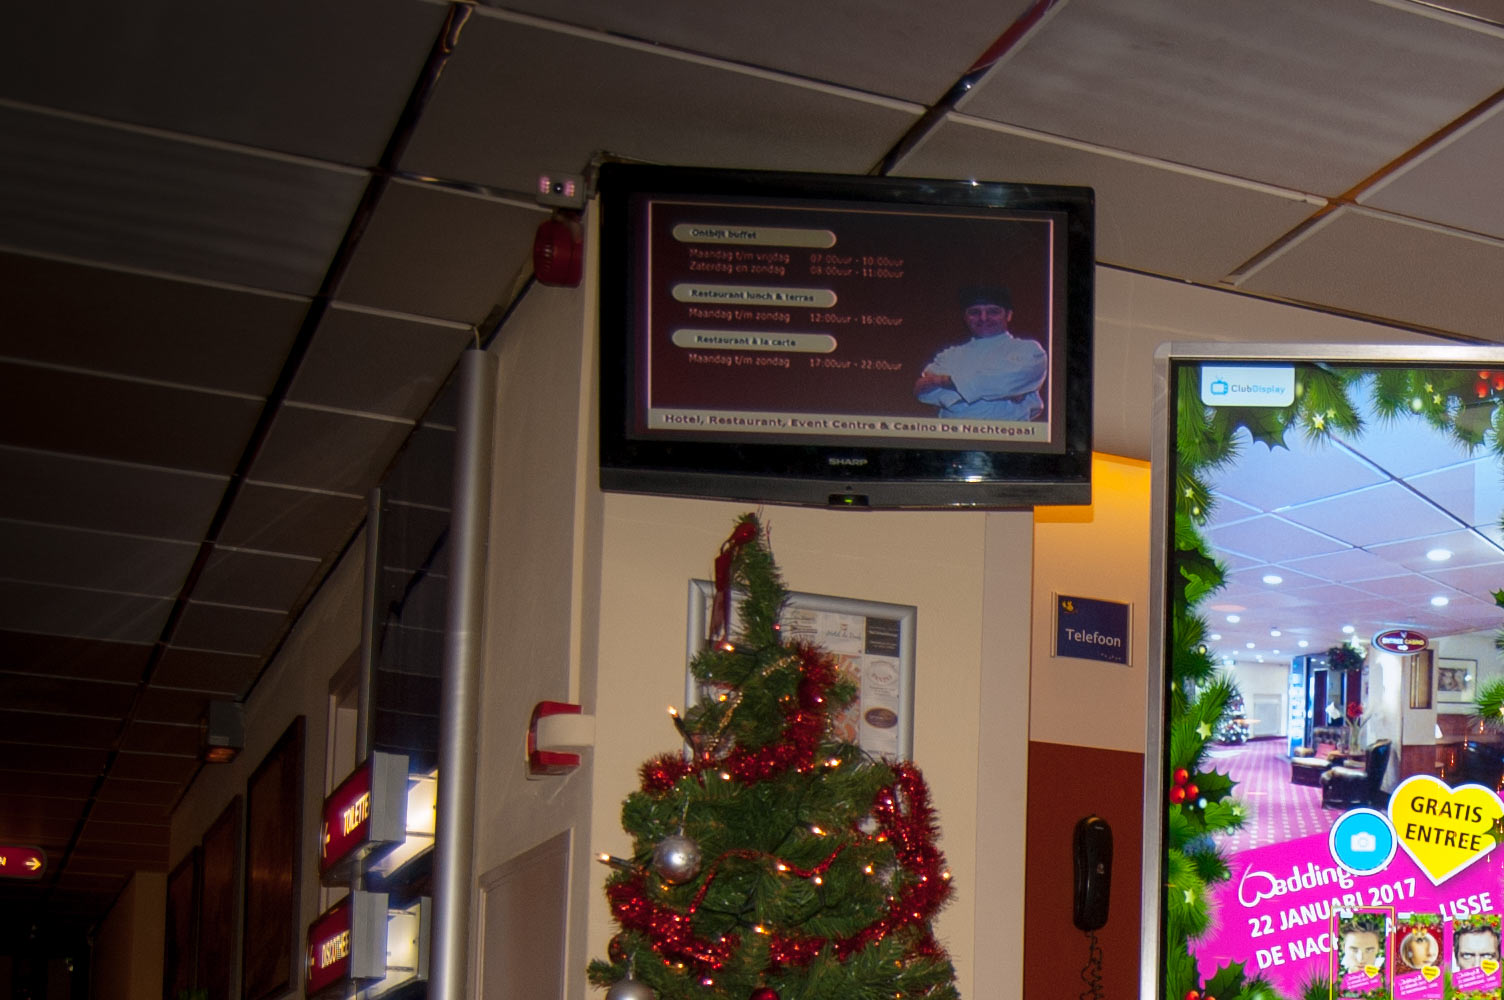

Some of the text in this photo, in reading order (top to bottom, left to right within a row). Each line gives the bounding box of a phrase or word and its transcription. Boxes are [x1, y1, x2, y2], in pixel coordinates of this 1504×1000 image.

[728, 229, 756, 239] buffet
[689, 248, 733, 262] Maandag
[689, 260, 786, 277] Zaterdag en zondag
[691, 289, 814, 302] Restaurant lunch & terras
[689, 308, 791, 324] Maandag t/m zondag
[696, 335, 749, 345] Restaurant
[760, 337, 769, 346] la
[771, 338, 796, 347] carte
[689, 353, 791, 369] Maandag t/m zondag
[1231, 384, 1286, 395] ClubDisplay
[664, 414, 1036, 436] Hotel, Restaurant, Event Centre & Casino De Nachtegaal
[828, 457, 868, 466] SHARP
[1065, 628, 1121, 648] Telefoon
[343, 790, 370, 837] TOILETTE
[1411, 796, 1483, 823] GRATIS
[1405, 823, 1481, 851] ENTREE
[1238, 862, 1357, 908] Wedding
[1248, 877, 1416, 938] 22 JANUARI 2017
[1256, 945, 1285, 970] DE
